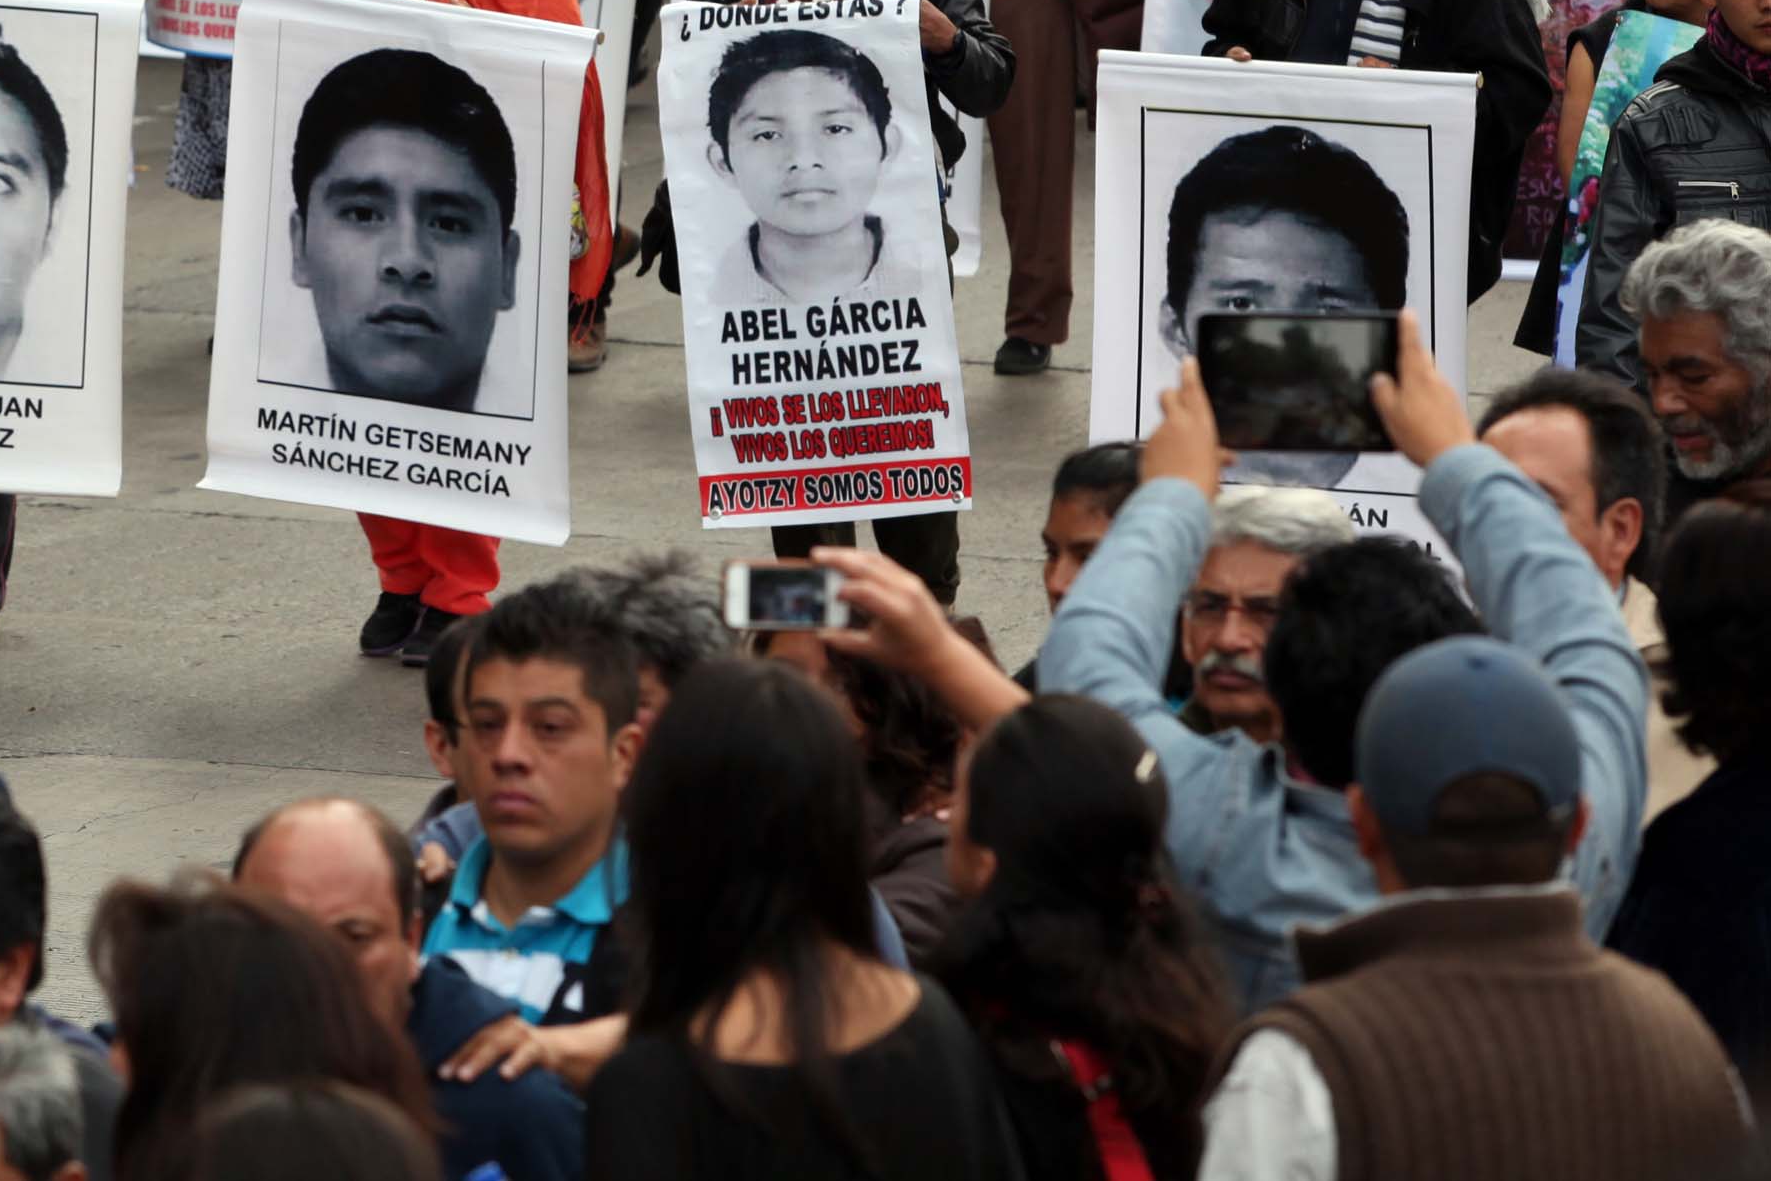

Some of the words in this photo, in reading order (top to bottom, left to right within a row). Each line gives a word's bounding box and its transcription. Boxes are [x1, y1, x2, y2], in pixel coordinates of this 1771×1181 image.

[721, 308, 797, 343] ABEL
[806, 296, 926, 338] GÁRCIA
[732, 340, 922, 385] HERNÁNDEZ
[723, 396, 779, 429] VIVOS
[781, 394, 807, 424] SE
[809, 391, 846, 423] LOS
[847, 381, 950, 419] LLEVARON,
[257, 407, 356, 442] MARTÍN
[365, 422, 532, 467] GETSEMANY
[731, 431, 788, 464] VIVOS
[790, 428, 827, 460] LOS
[828, 418, 935, 459] QUEREMOS!
[272, 441, 399, 482] SÁNCHEZ
[407, 464, 510, 497] GARCÍA
[709, 476, 797, 513] AYOTZY
[804, 470, 883, 505] SOMOS
[889, 464, 963, 497] TODOS
